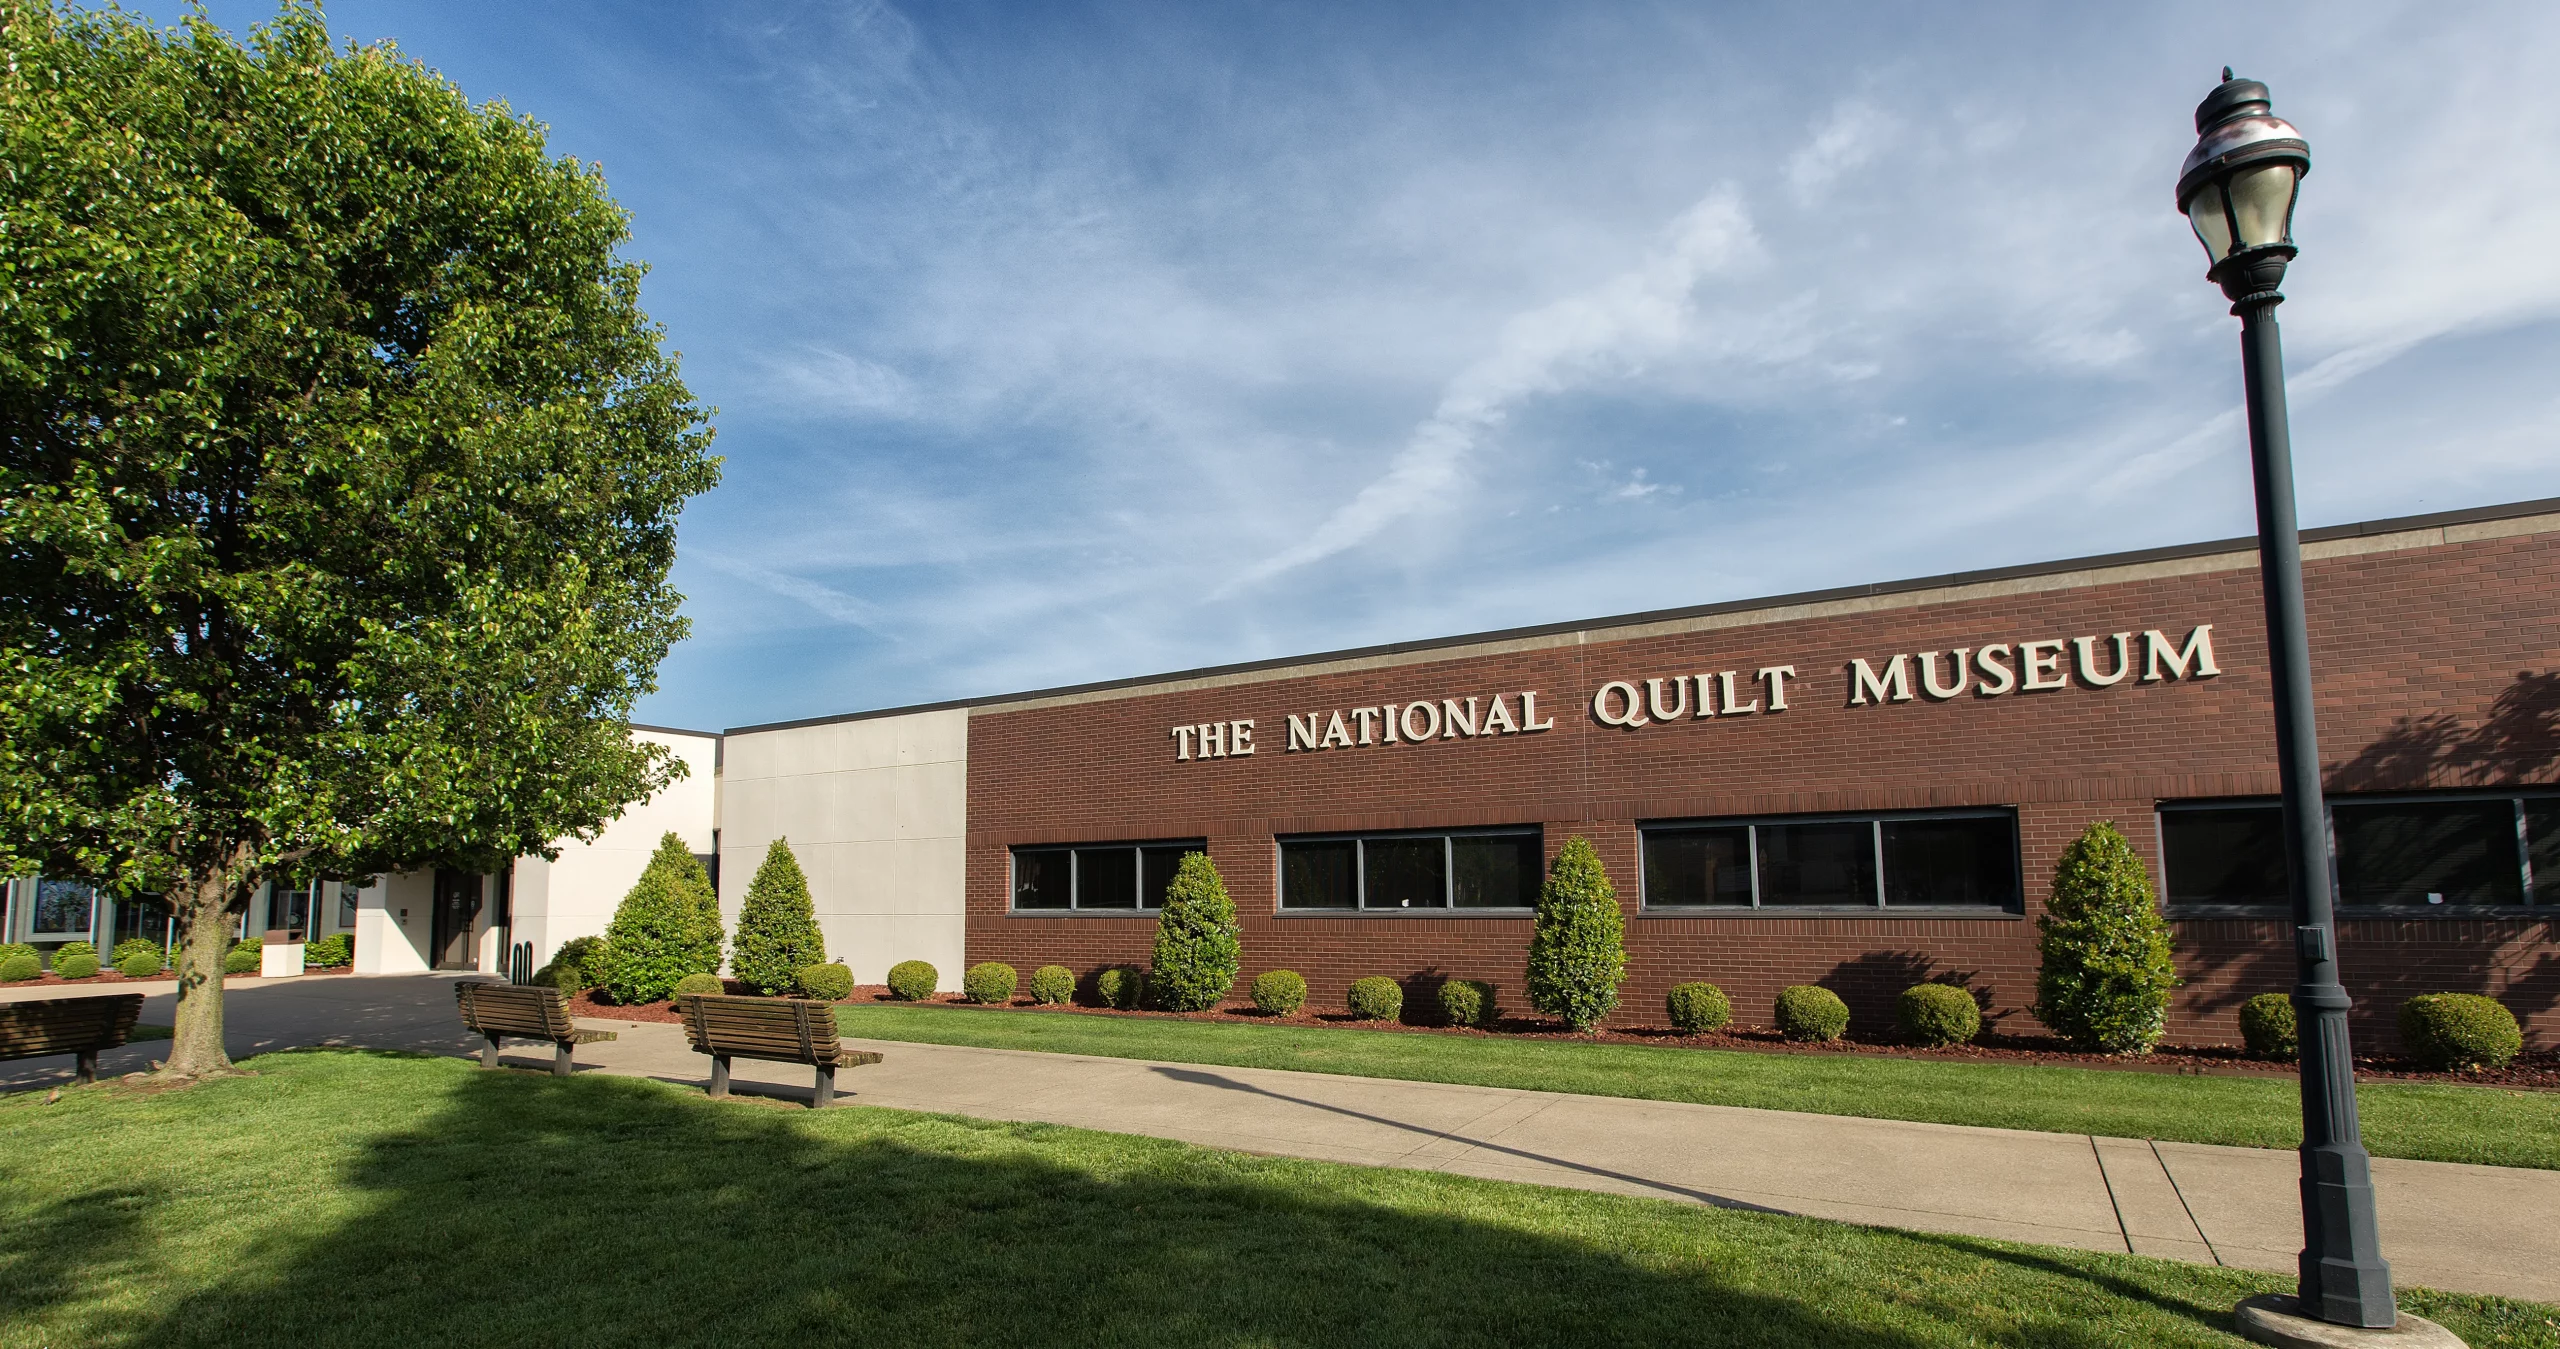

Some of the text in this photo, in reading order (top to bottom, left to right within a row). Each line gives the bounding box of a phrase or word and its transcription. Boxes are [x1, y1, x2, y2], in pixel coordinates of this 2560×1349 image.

[1172, 624, 2222, 760] THE NATIONAL QUILT MUSEUM
